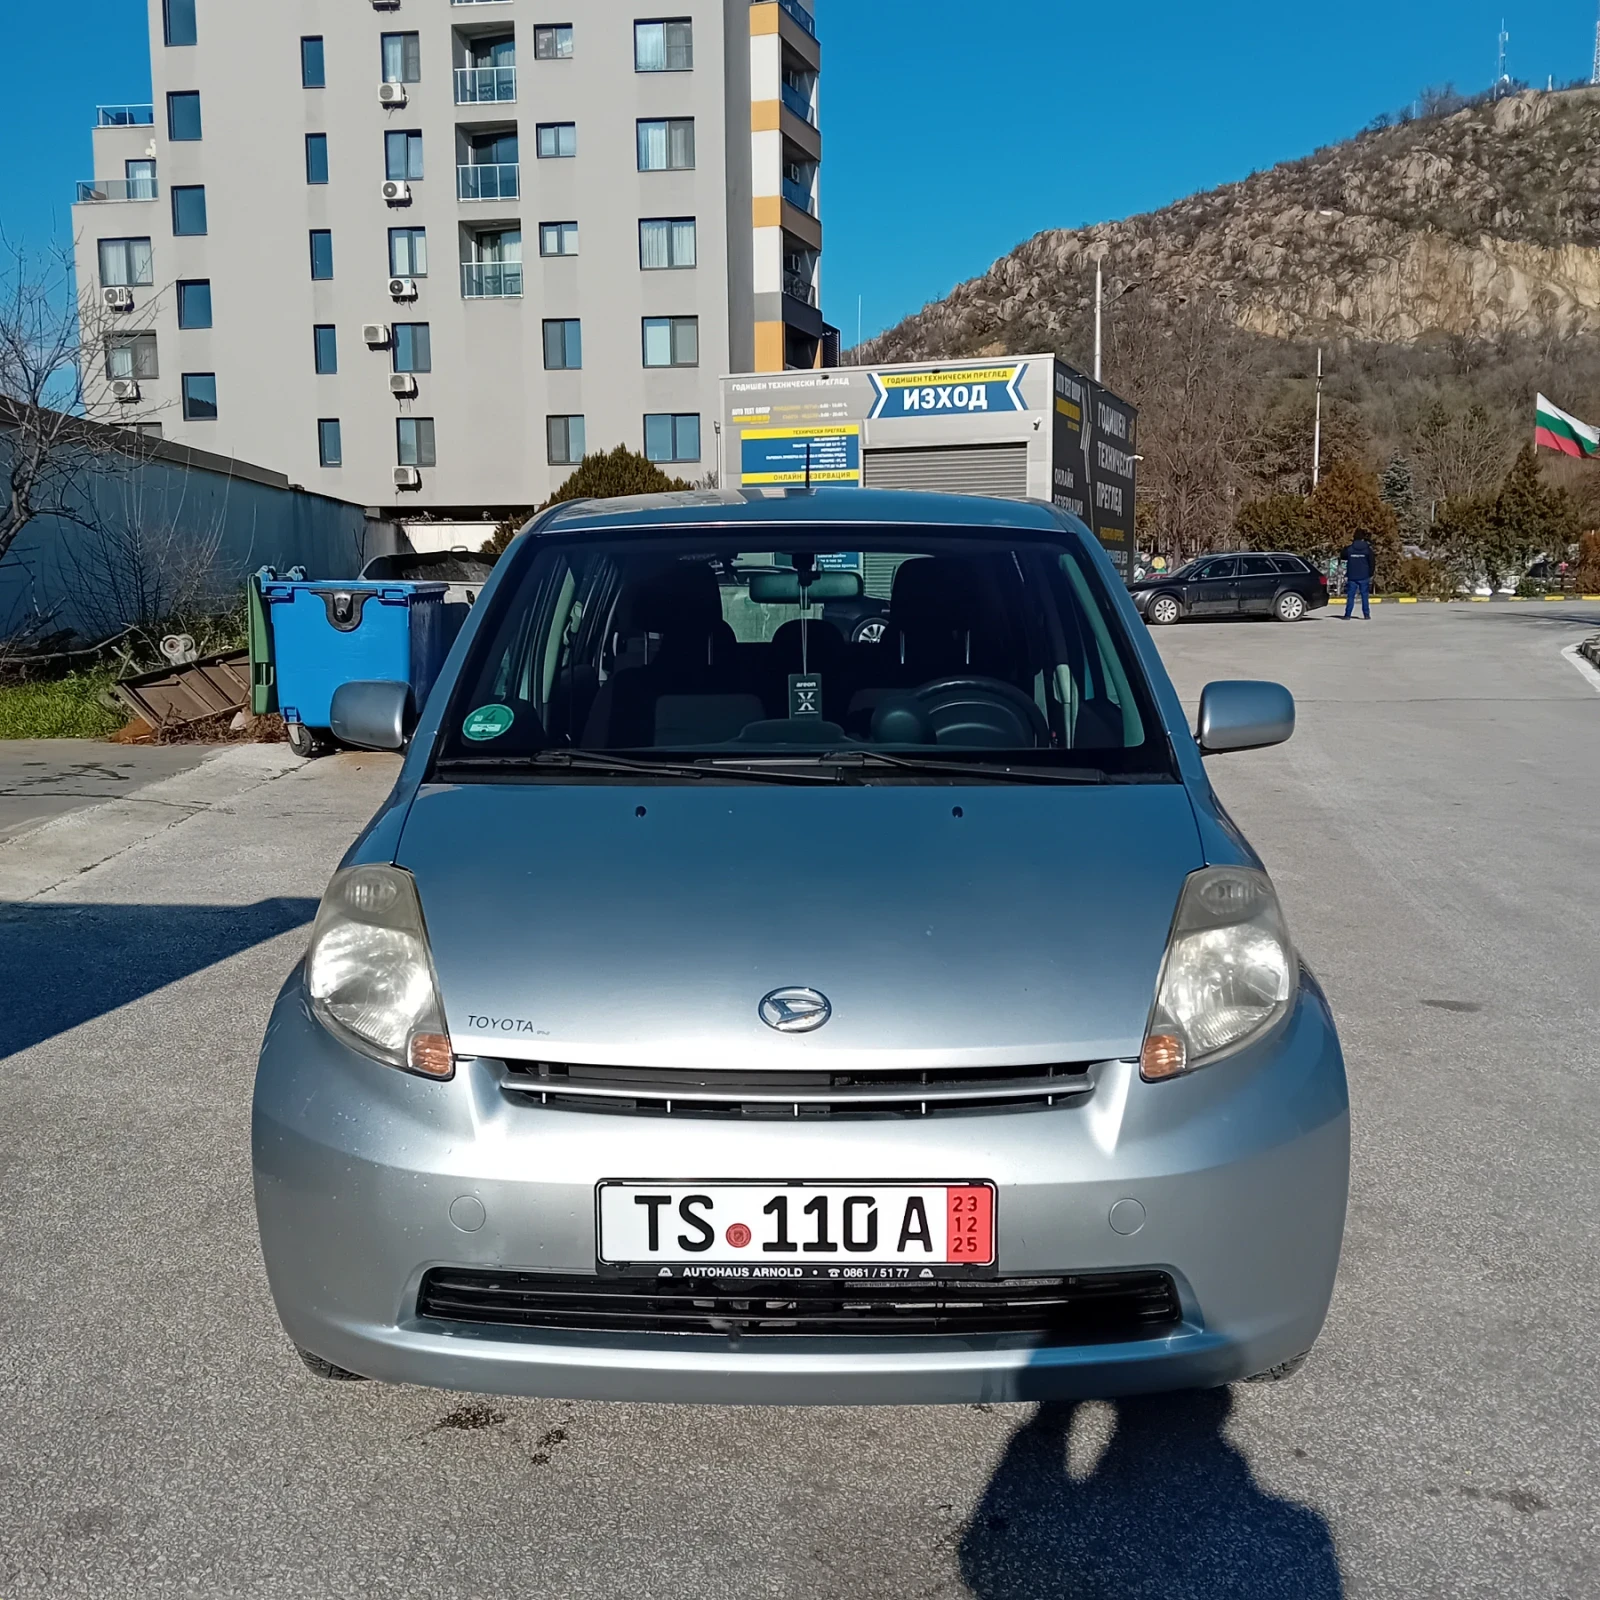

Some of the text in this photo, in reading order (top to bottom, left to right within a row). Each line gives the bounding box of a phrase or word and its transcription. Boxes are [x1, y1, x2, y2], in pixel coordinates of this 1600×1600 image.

[732, 377, 850, 392] ГОДИШЕН ТЕХНИЧЕСКИ ПРЕГЛЕД
[887, 370, 1008, 385] ГОДИШЕН ТЕХНИЧЕСКИ ПРЕГЛЕД
[903, 384, 988, 411] ИЗХОД
[1097, 401, 1126, 439] ГОДИШЕН
[1097, 440, 1133, 480] ТЕХНИЧЕСКИ
[773, 471, 851, 481] ОНЛАЙН ЕЗЕРВАЦИЯ
[1096, 481, 1123, 517] ПРЕГЛЕД
[484, 709, 497, 723] 4
[468, 1015, 534, 1033] TOYOTA
[952, 1196, 978, 1213] 23
[634, 1194, 933, 1252] TS 110 A
[954, 1216, 978, 1233] 12
[952, 1236, 978, 1253] 25
[683, 1267, 750, 1277] AUTOHAUS
[752, 1267, 803, 1277] ARNOLD
[843, 1268, 869, 1278] 0861
